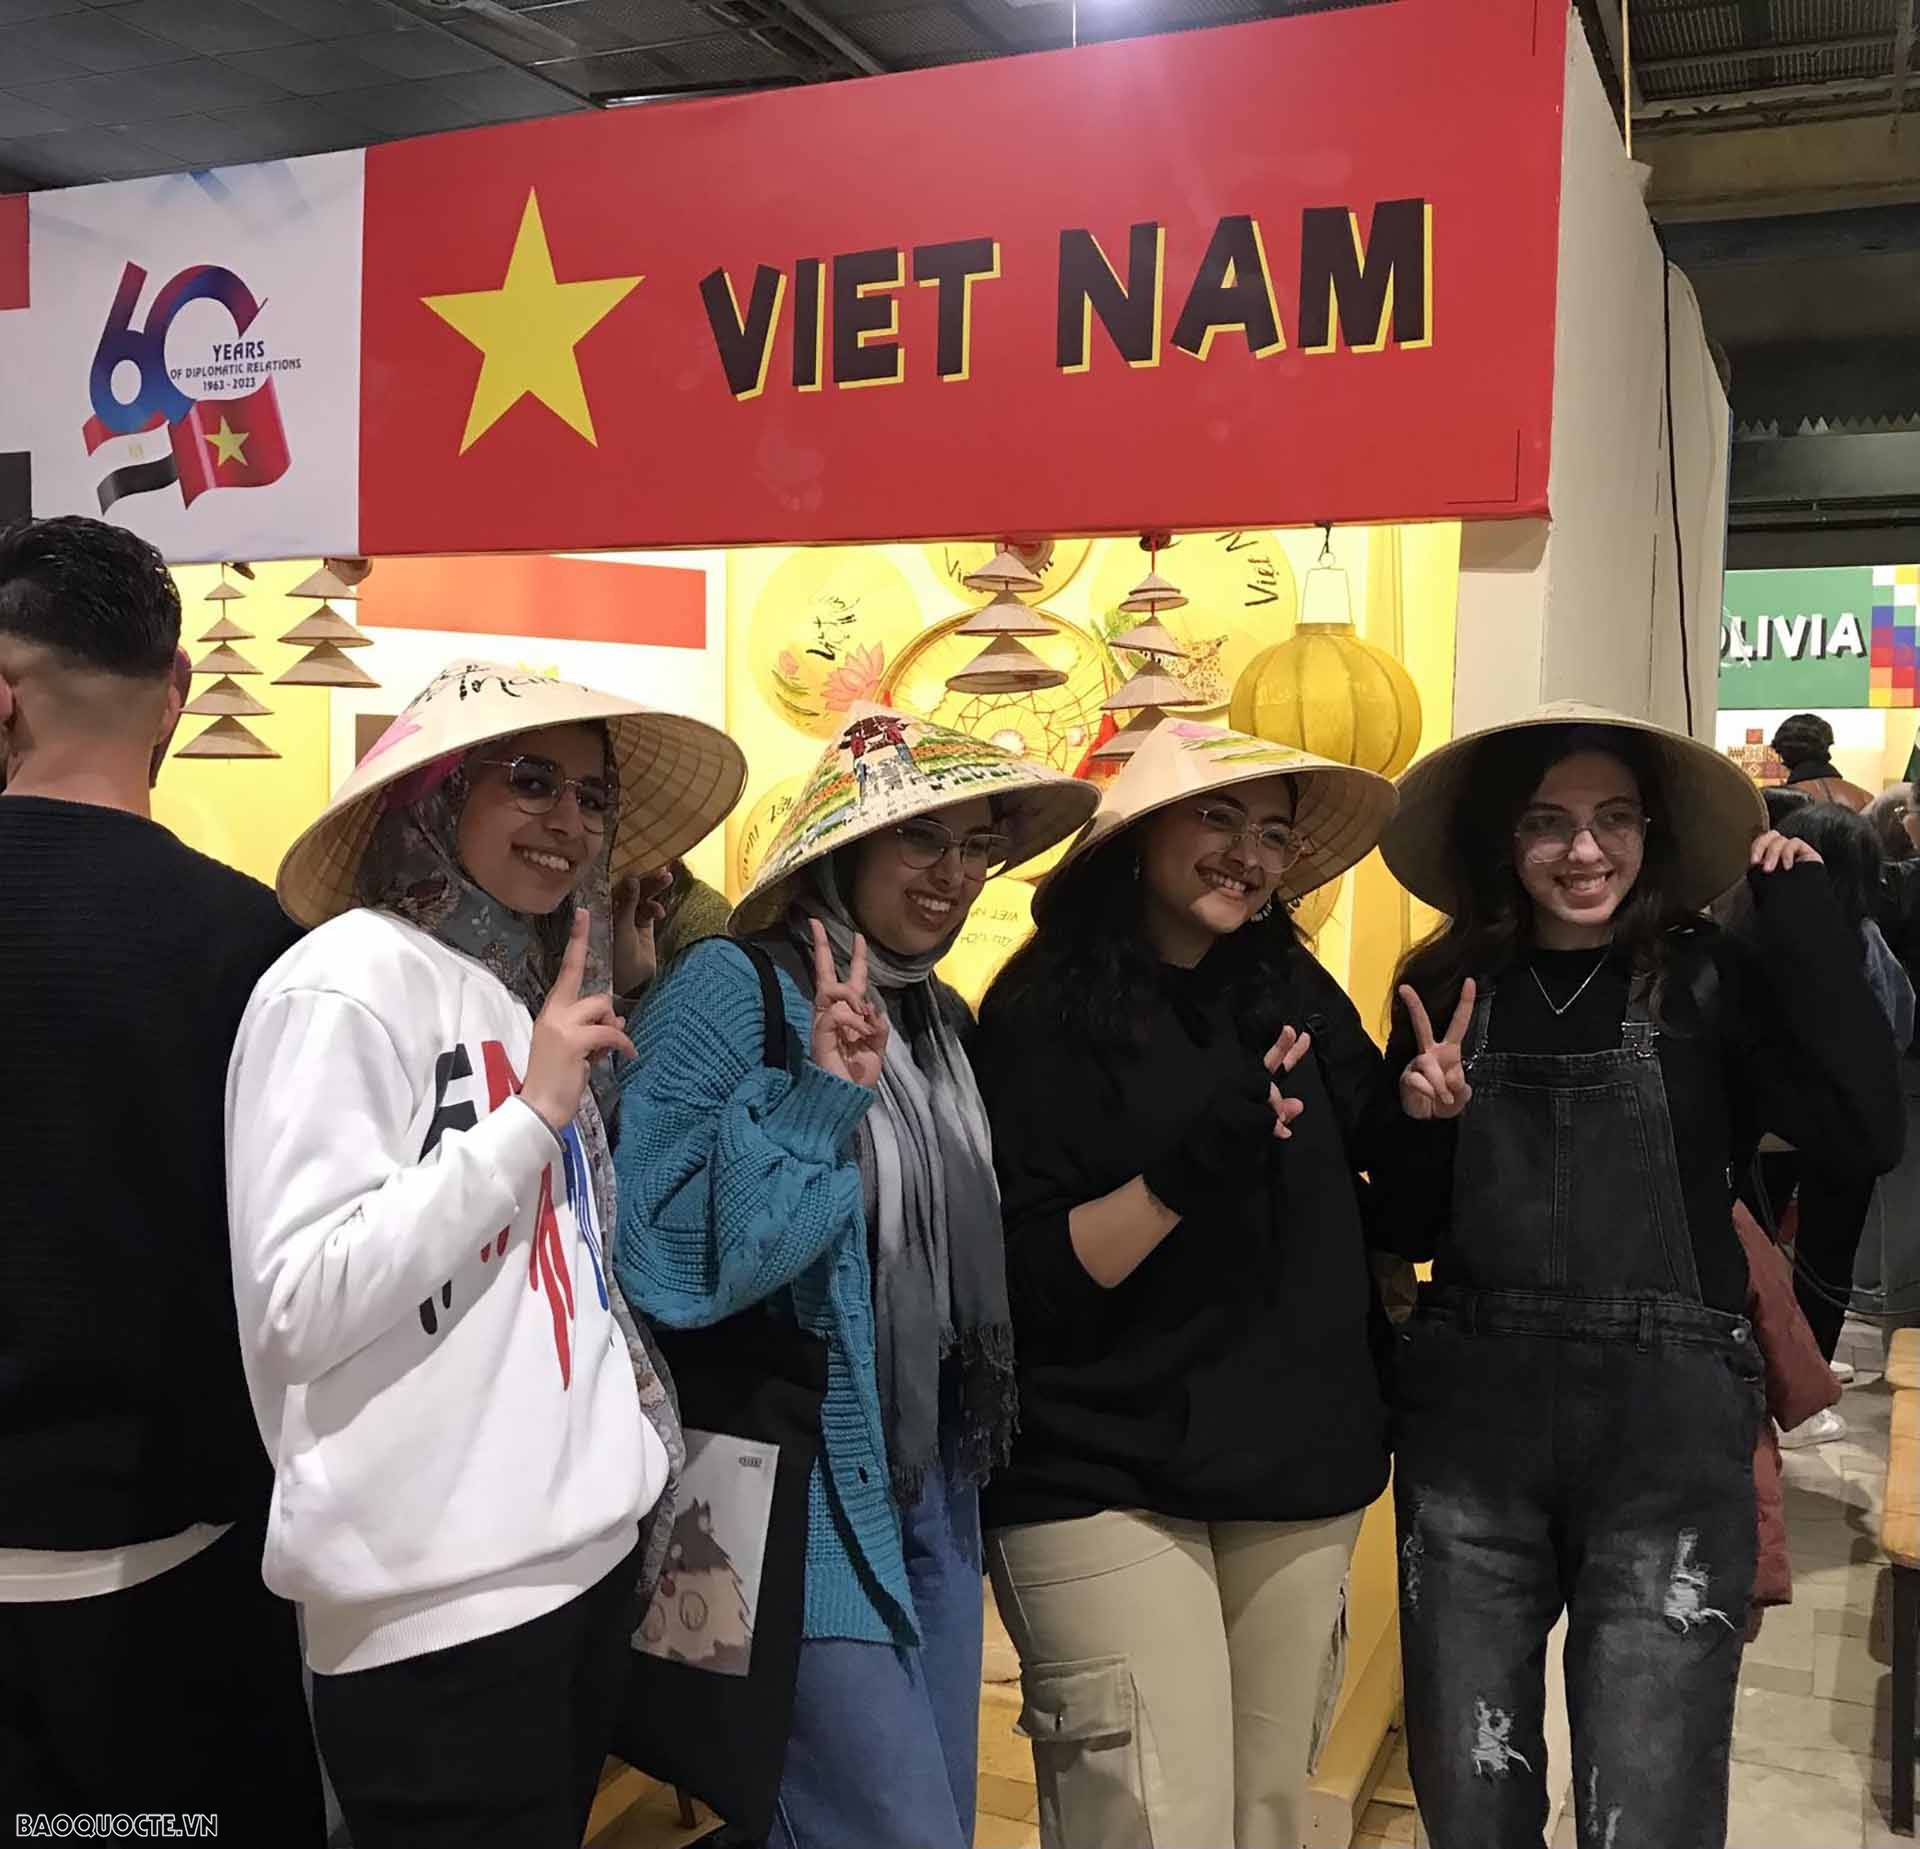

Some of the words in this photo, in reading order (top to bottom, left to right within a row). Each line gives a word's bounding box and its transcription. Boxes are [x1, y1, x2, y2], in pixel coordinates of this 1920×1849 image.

[698, 236, 1000, 401] VIET
[1055, 198, 1432, 374] NAM
[212, 340, 265, 362] YEARS
[170, 368, 183, 380] OF
[185, 363, 244, 379] DIPLOMATIC
[246, 358, 302, 374] RELATIONS
[203, 380, 225, 392] 1963
[232, 377, 256, 390] 2023
